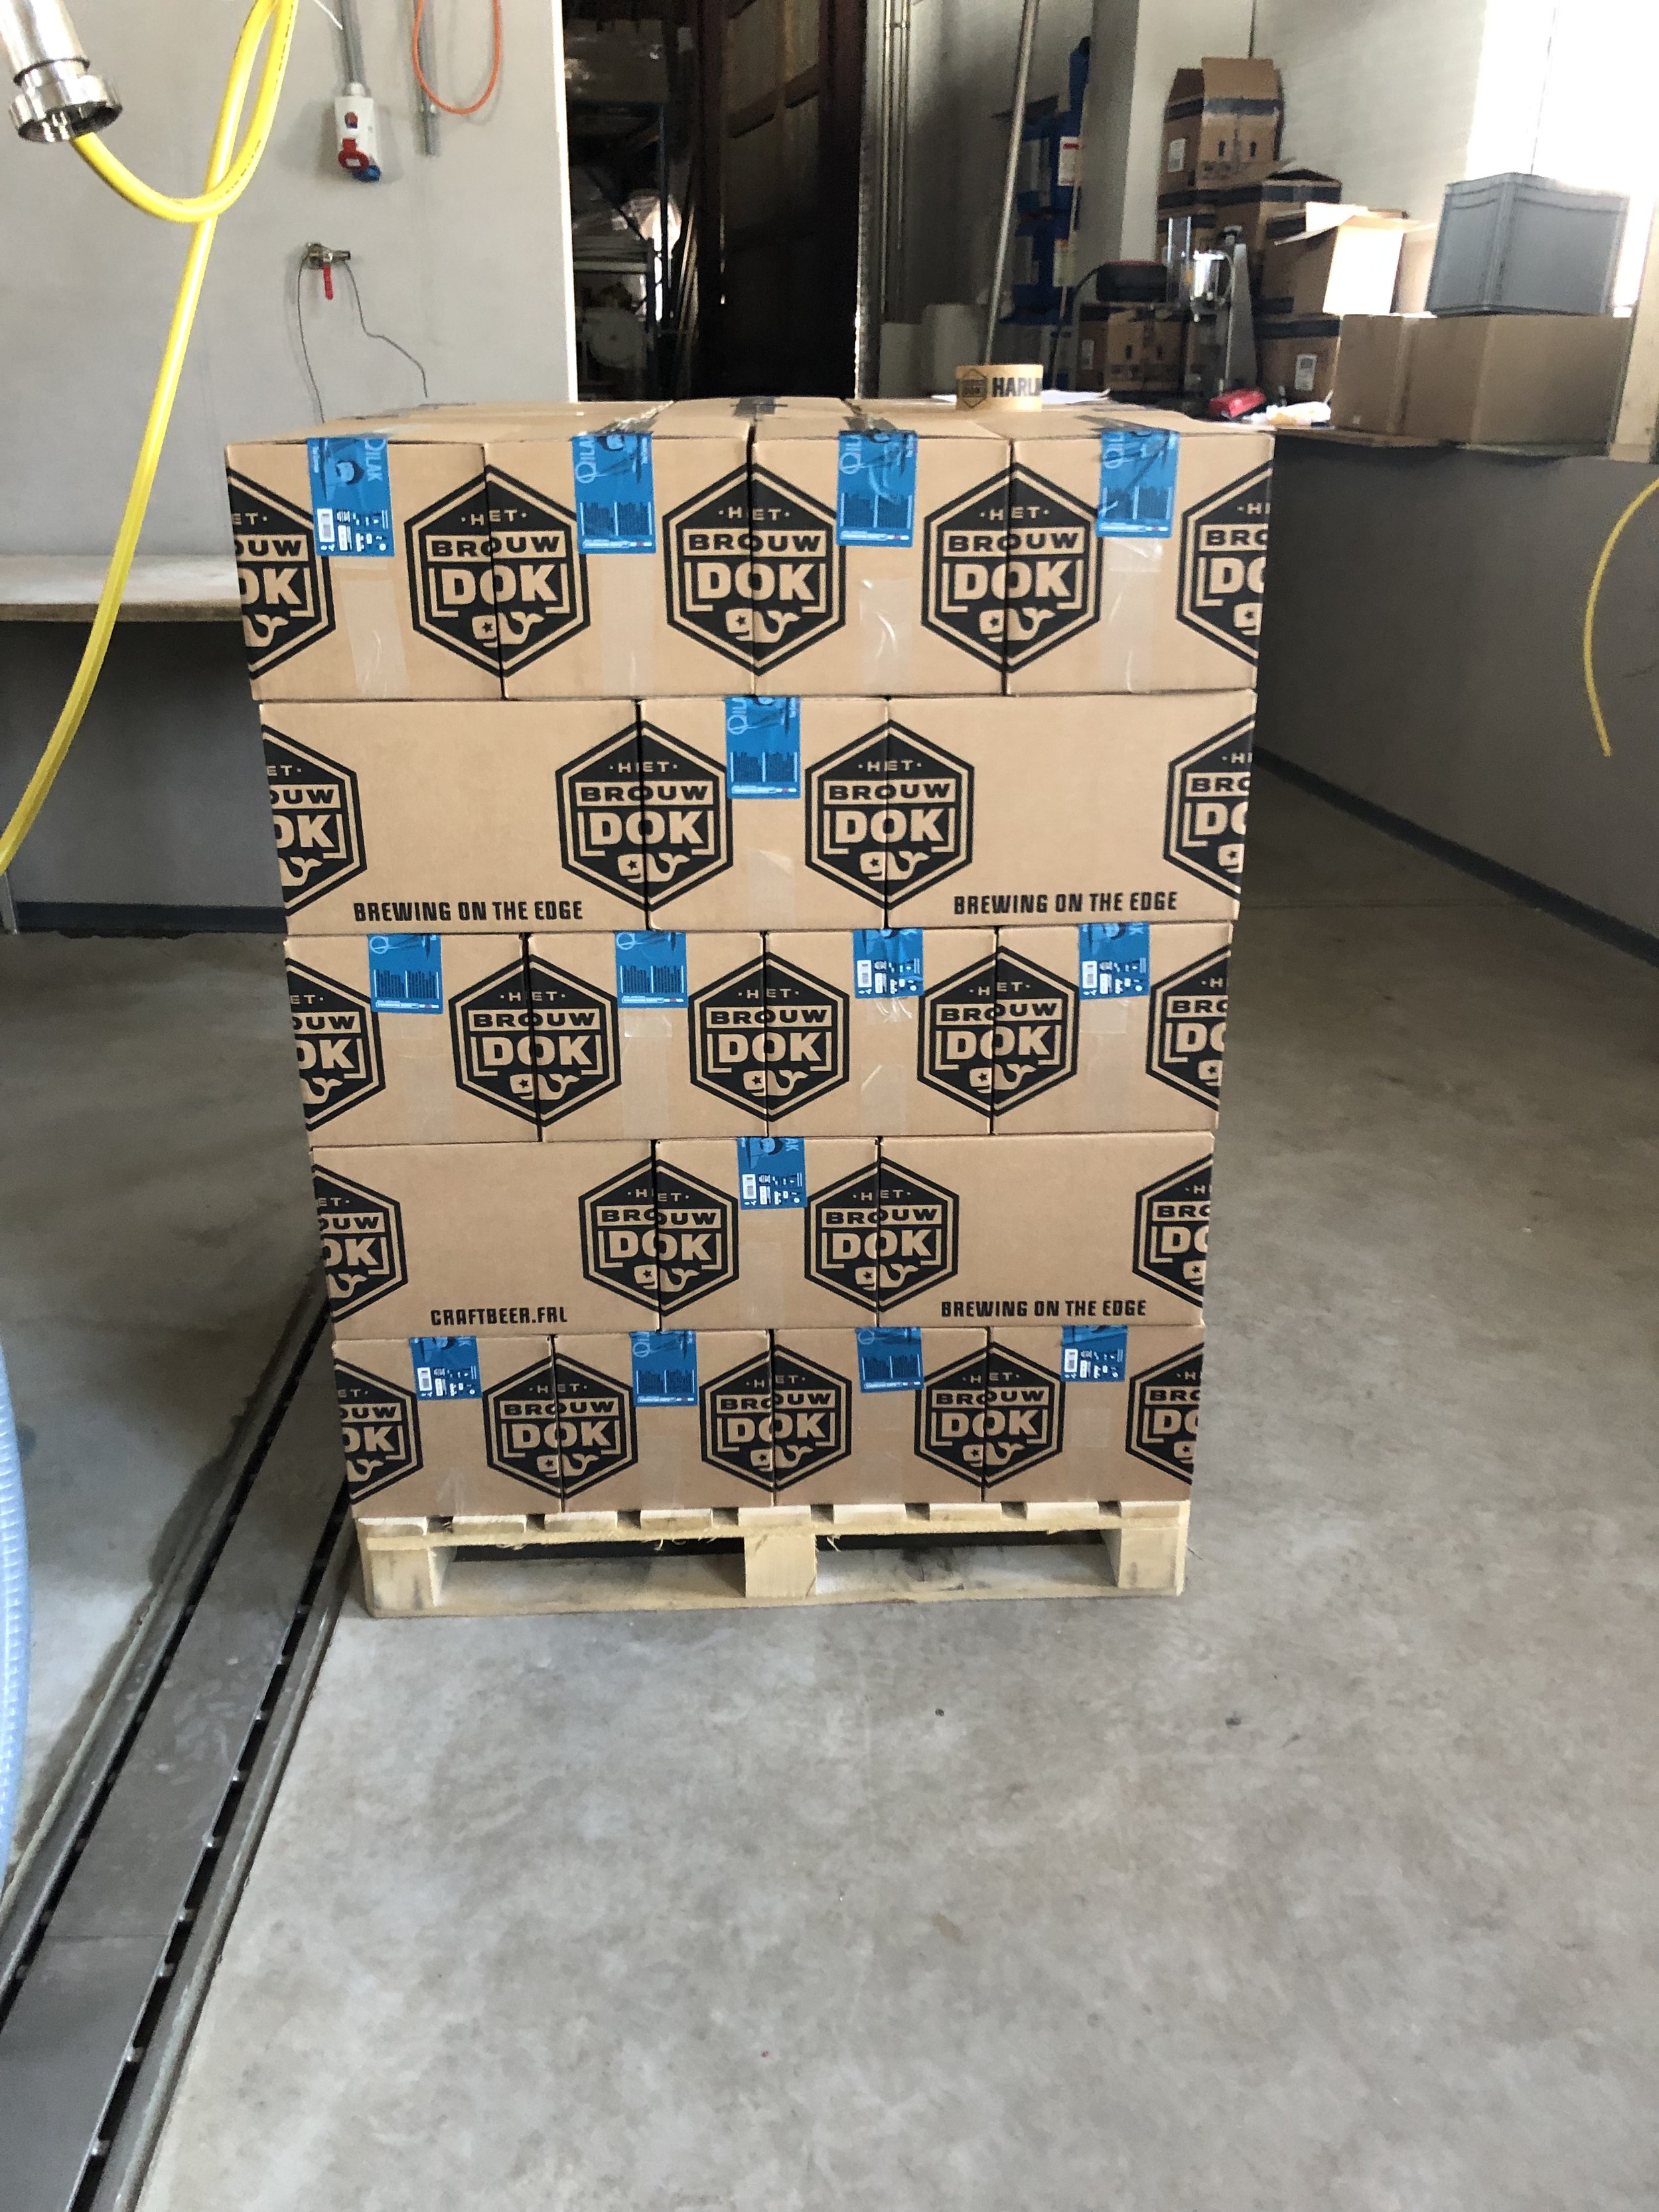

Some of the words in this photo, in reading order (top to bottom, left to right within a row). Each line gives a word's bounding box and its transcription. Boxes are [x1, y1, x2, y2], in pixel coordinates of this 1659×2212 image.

[232, 513, 257, 525] ET
[470, 510, 517, 525] HET
[728, 506, 781, 520] HET
[989, 506, 1040, 520] HET
[689, 534, 821, 552] BROUW
[949, 533, 1078, 552] BROUW
[1206, 530, 1267, 546] BRO
[235, 540, 302, 557] OUW
[432, 536, 559, 557] BROUW
[239, 567, 301, 605] OK
[441, 565, 557, 605] DOK
[697, 562, 815, 601] DOK
[954, 560, 1072, 601] DOK
[267, 765, 292, 776] ET
[618, 761, 670, 773] HET
[867, 761, 913, 772] HET
[830, 784, 950, 800] BROUW
[1192, 777, 1250, 792] BRO
[269, 790, 334, 804] OUW
[581, 786, 708, 801] BROUW
[273, 814, 334, 848] OK
[590, 810, 703, 845] DOK
[835, 809, 944, 843] DOK
[353, 902, 451, 921] BREWING
[458, 901, 487, 921] ON
[492, 901, 528, 921] THE
[534, 901, 583, 920] EDGE
[954, 894, 1048, 915] BREWING
[1055, 893, 1082, 913] ON
[1090, 892, 1123, 912] THE
[1129, 891, 1178, 911] EDGE
[509, 991, 557, 1001] HET
[747, 988, 792, 999] HET
[978, 982, 1023, 995] HET
[291, 995, 315, 1004] ET
[1172, 1000, 1228, 1013] BRO
[473, 1013, 595, 1027] BROUW
[711, 1009, 827, 1025] BROUW
[941, 1003, 1057, 1021] BROUW
[293, 1016, 355, 1030] OUW
[482, 1035, 592, 1066] DOK
[718, 1032, 822, 1063] DOK
[946, 1026, 1051, 1059] DOK
[296, 1039, 354, 1069] OK
[319, 1197, 342, 1207] ET
[636, 1189, 681, 1202] HET
[861, 1189, 904, 1201] HET
[601, 1208, 716, 1225] BROUW
[826, 1209, 938, 1224] BROUW
[1157, 1205, 1210, 1218] BRO
[320, 1217, 379, 1230] OUW
[324, 1238, 378, 1266] OK
[609, 1230, 711, 1260] DOK
[832, 1229, 932, 1260] DOK
[941, 1300, 1027, 1317] BREWING
[1034, 1300, 1060, 1317] ON
[1065, 1300, 1097, 1317] THE
[1102, 1299, 1147, 1316] EDGE
[754, 1375, 798, 1388] HET
[971, 1372, 1013, 1384] HET
[338, 1388, 361, 1398] ET
[538, 1383, 580, 1394] HET
[1150, 1390, 1200, 1402] BRO
[720, 1391, 832, 1410] BROUW
[936, 1390, 1045, 1406] BROUW
[340, 1406, 397, 1419] OUW
[504, 1401, 614, 1416] BROUW
[727, 1412, 826, 1443] DOK
[941, 1410, 1038, 1438] DOK
[342, 1426, 394, 1453] OK
[512, 1422, 611, 1449] DOK
